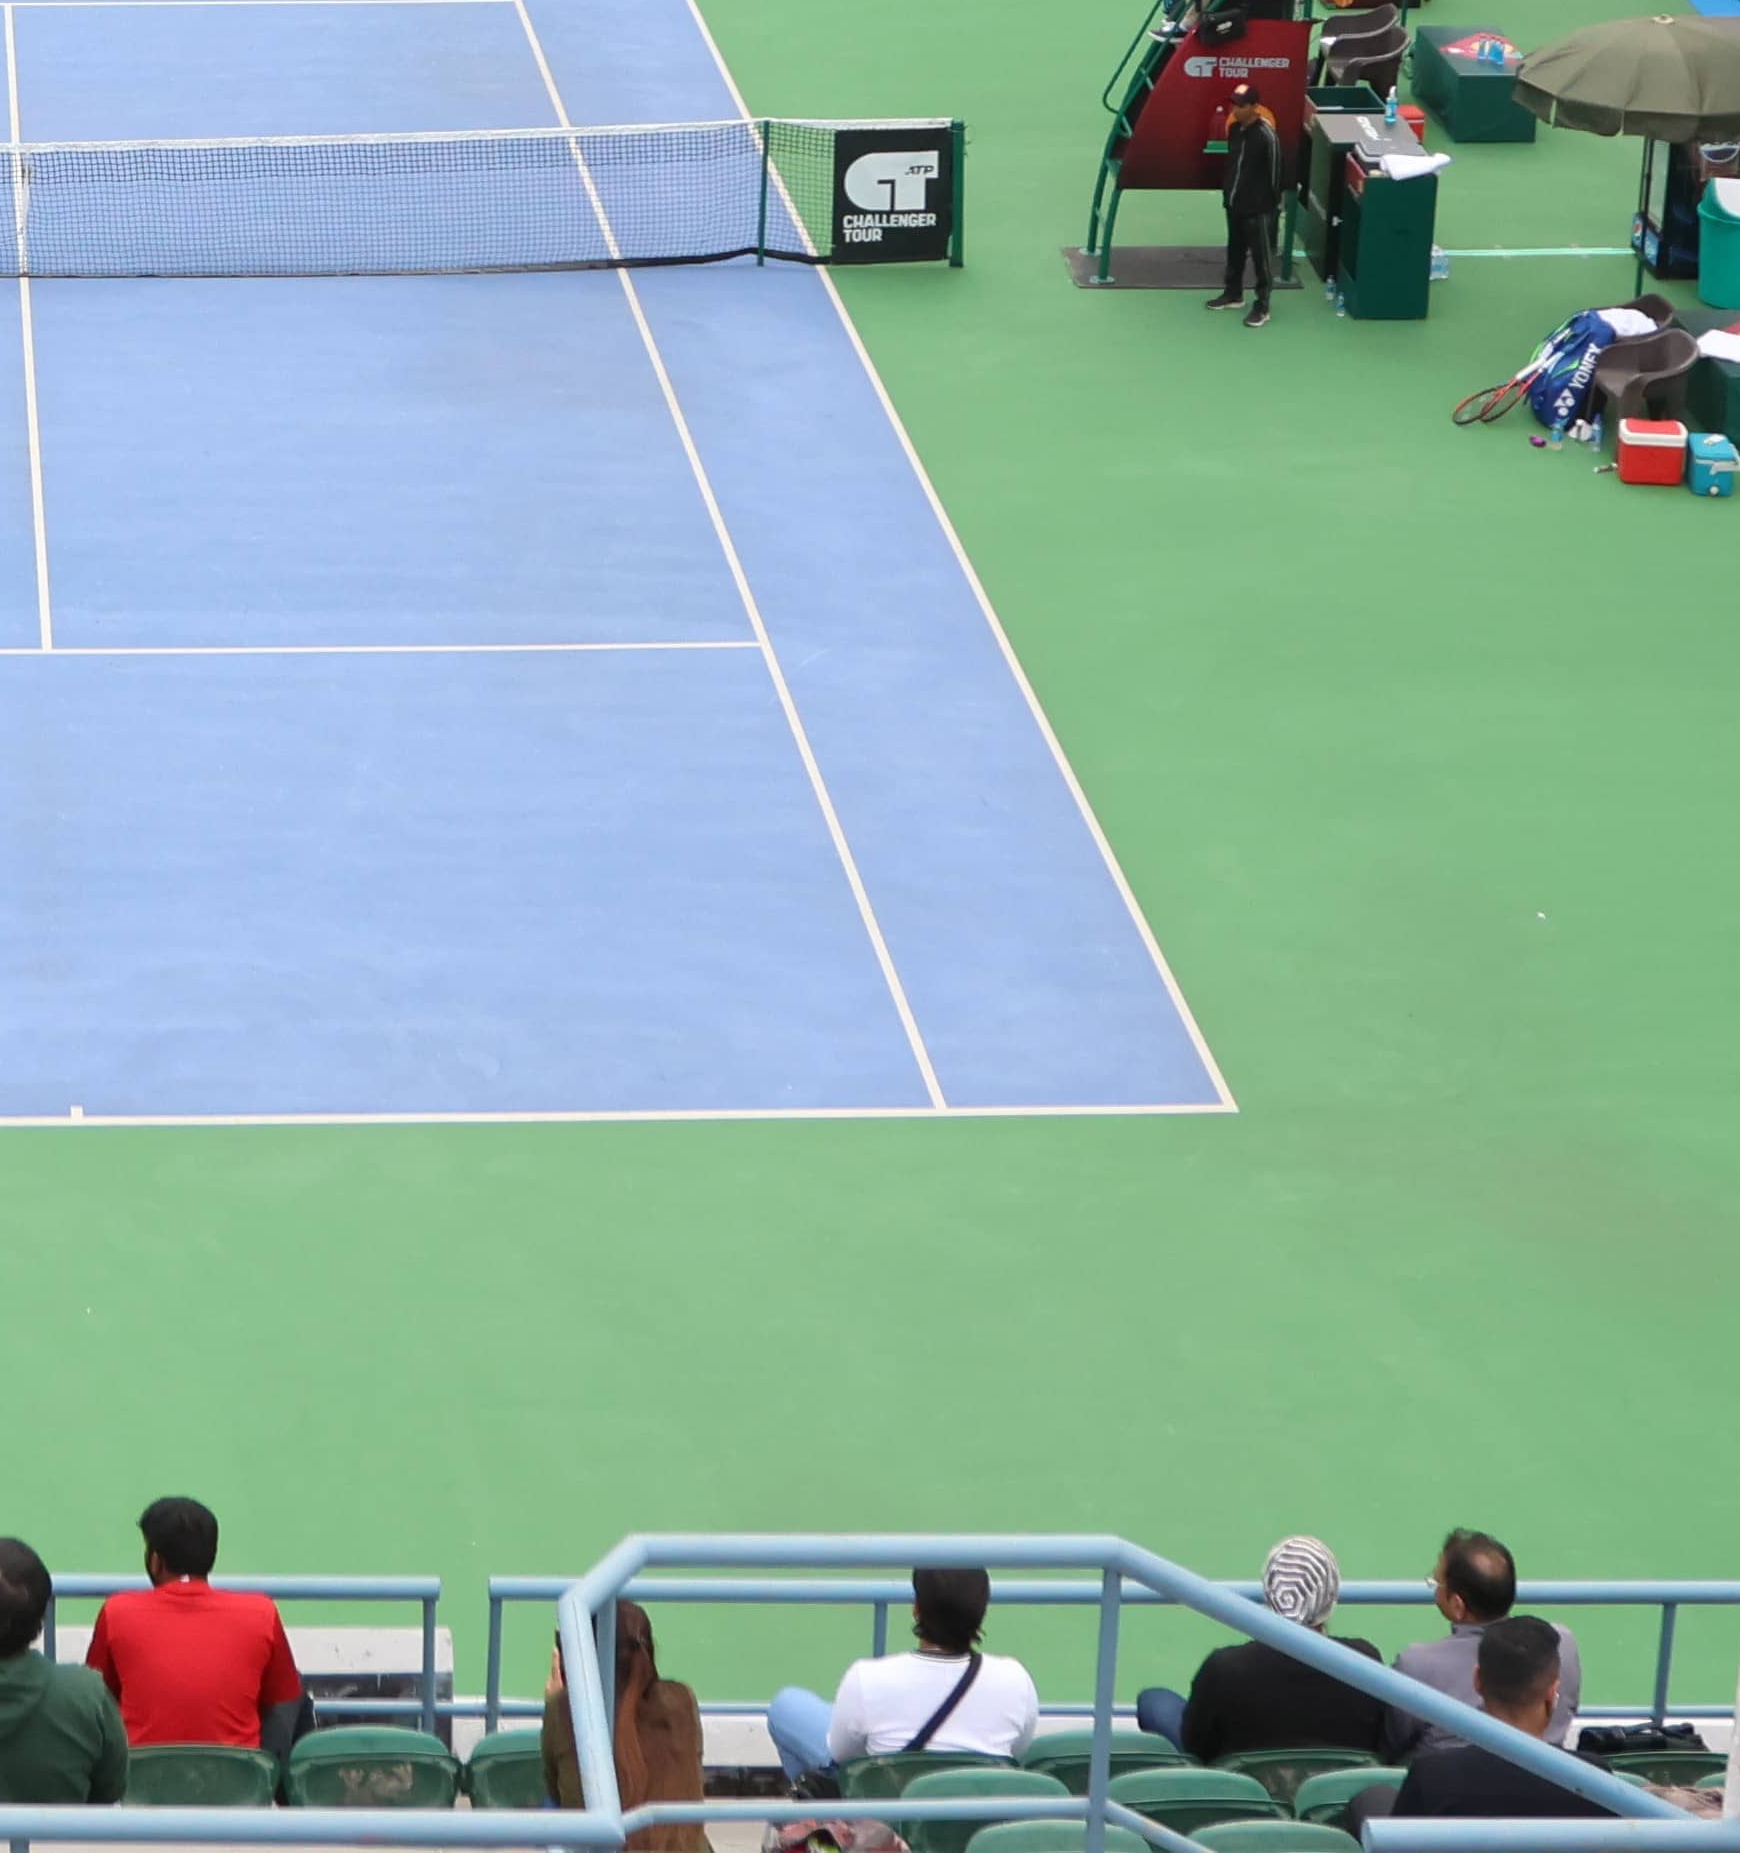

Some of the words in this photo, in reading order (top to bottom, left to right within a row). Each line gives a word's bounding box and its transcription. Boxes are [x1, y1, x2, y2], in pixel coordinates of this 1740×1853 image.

[1219, 58, 1290, 68] CHALLENGER
[1219, 68, 1248, 78] TOUR
[905, 166, 933, 176] ATP
[843, 213, 936, 228] CHALLENGER
[843, 228, 882, 243] TOUR
